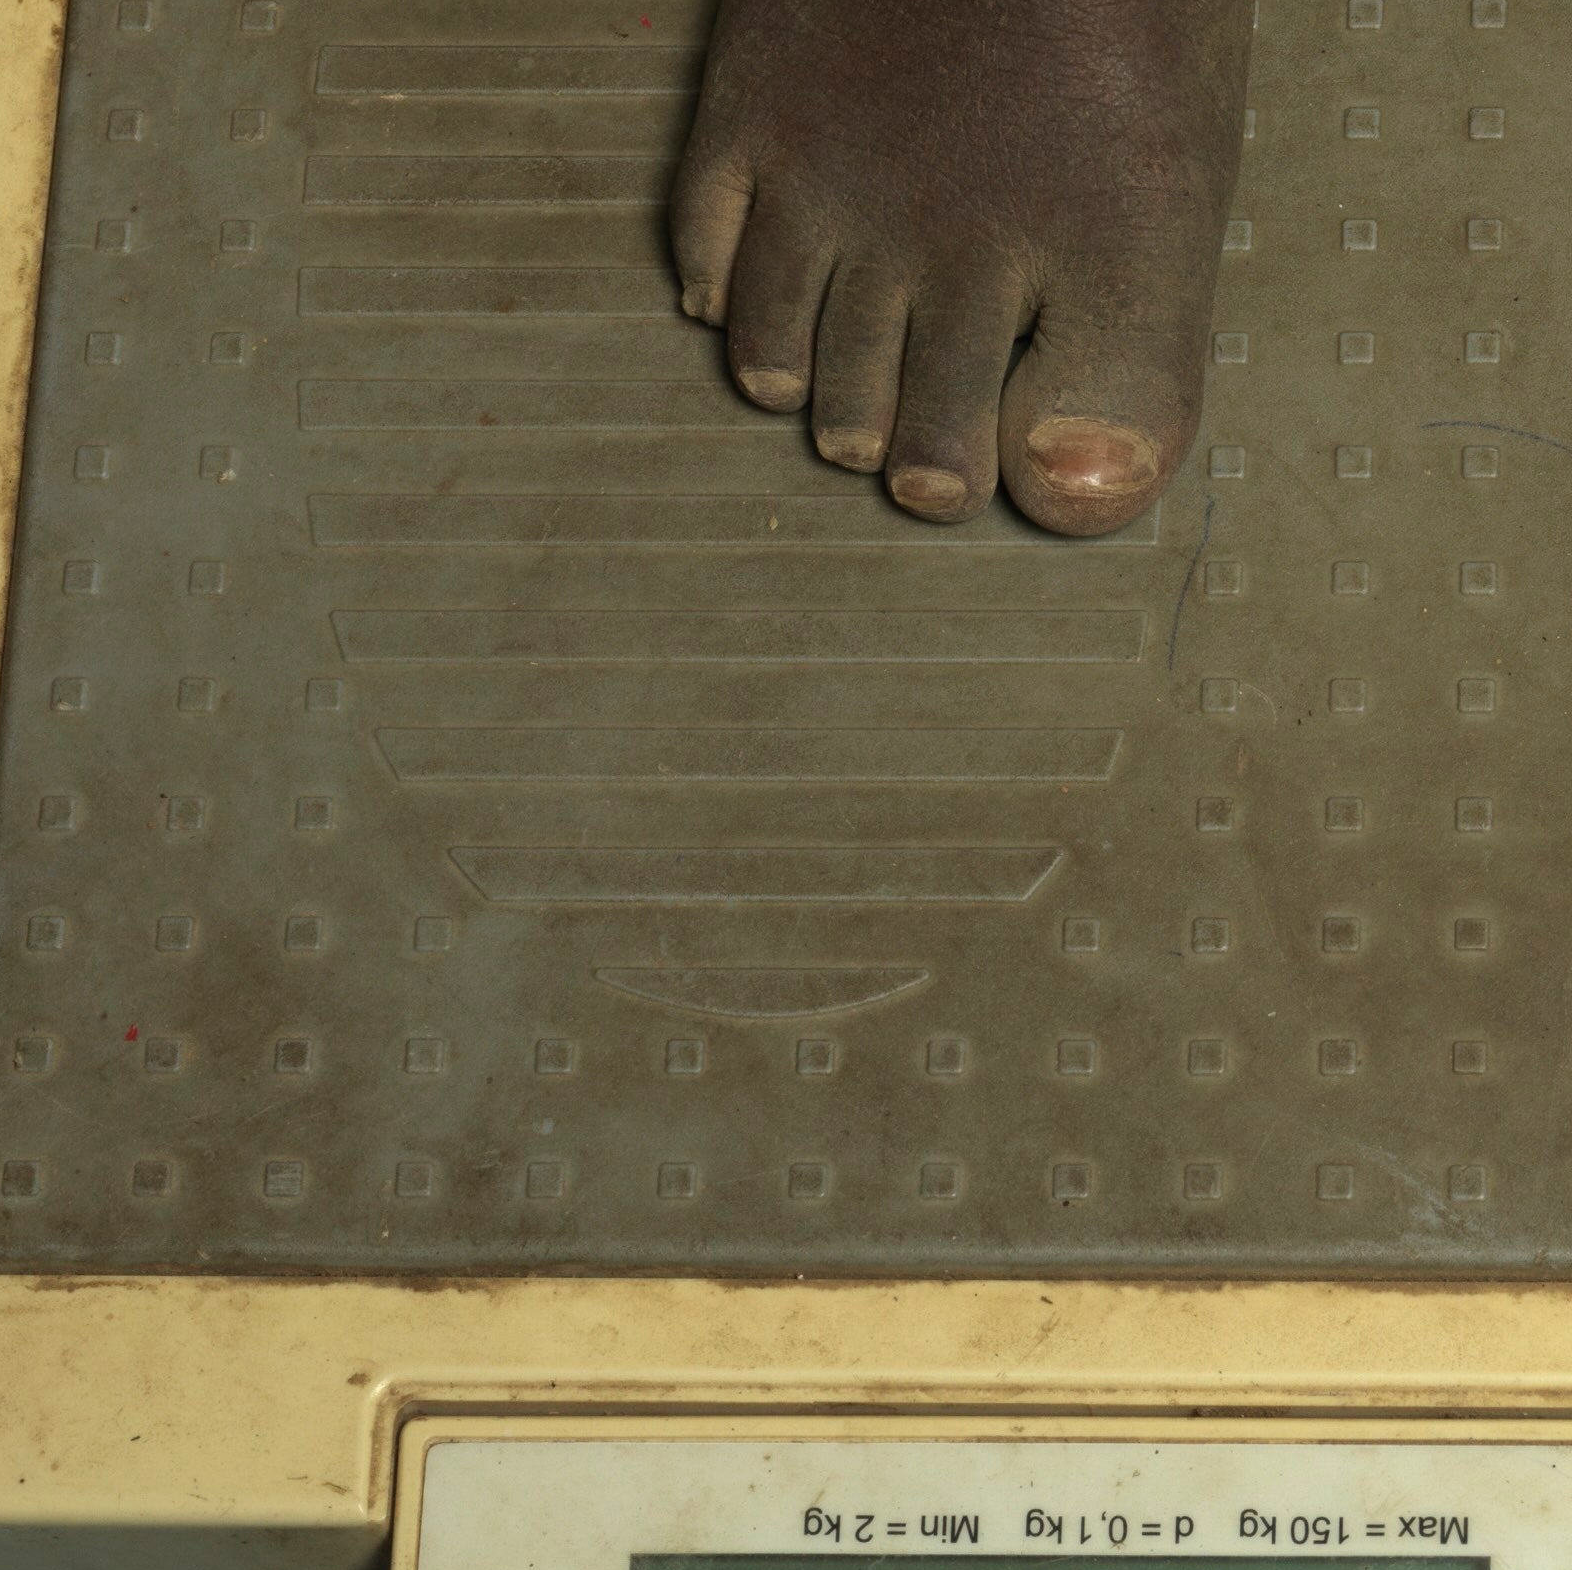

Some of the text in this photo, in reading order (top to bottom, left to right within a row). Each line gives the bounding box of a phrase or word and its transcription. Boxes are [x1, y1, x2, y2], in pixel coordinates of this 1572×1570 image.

[803, 1507, 842, 1543] kg
[854, 1514, 876, 1543] 2
[886, 1521, 907, 1536] =
[920, 1514, 980, 1544] Min
[1025, 1508, 1063, 1545] kg
[1141, 1523, 1162, 1537] =
[1174, 1515, 1195, 1545] d
[1239, 1508, 1278, 1546] kg
[1290, 1515, 1350, 1546] 150
[1365, 1523, 1386, 1537] =
[1397, 1515, 1470, 1546] Max
